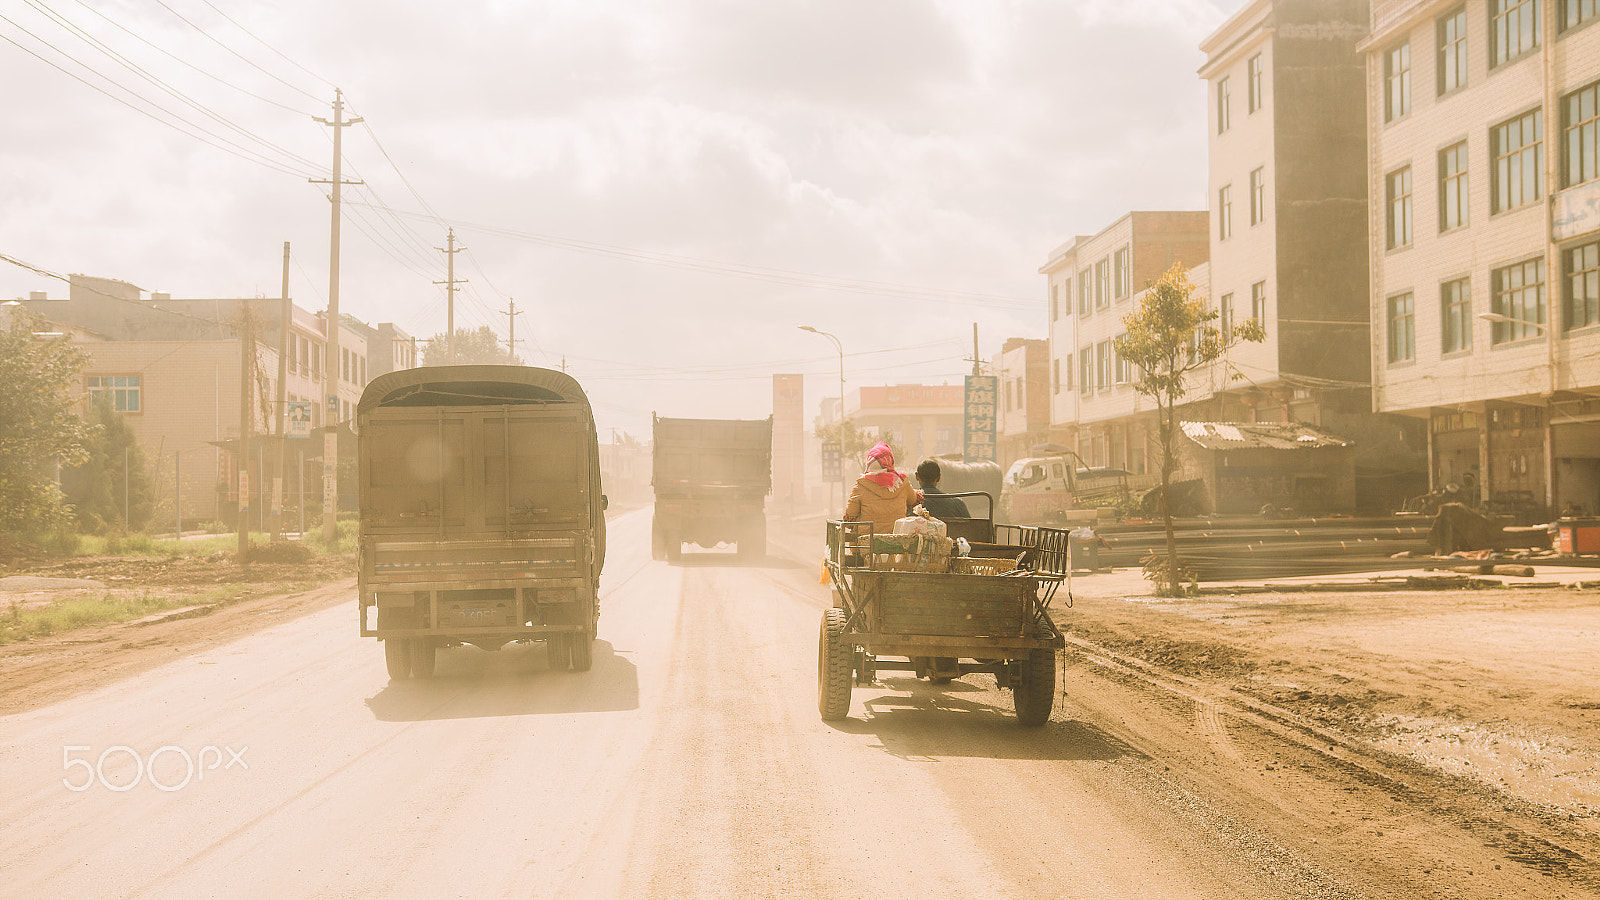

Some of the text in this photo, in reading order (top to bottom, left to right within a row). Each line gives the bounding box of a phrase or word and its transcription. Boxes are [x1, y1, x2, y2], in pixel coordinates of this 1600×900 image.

[967, 377, 995, 462] 隽旗钢材直销
